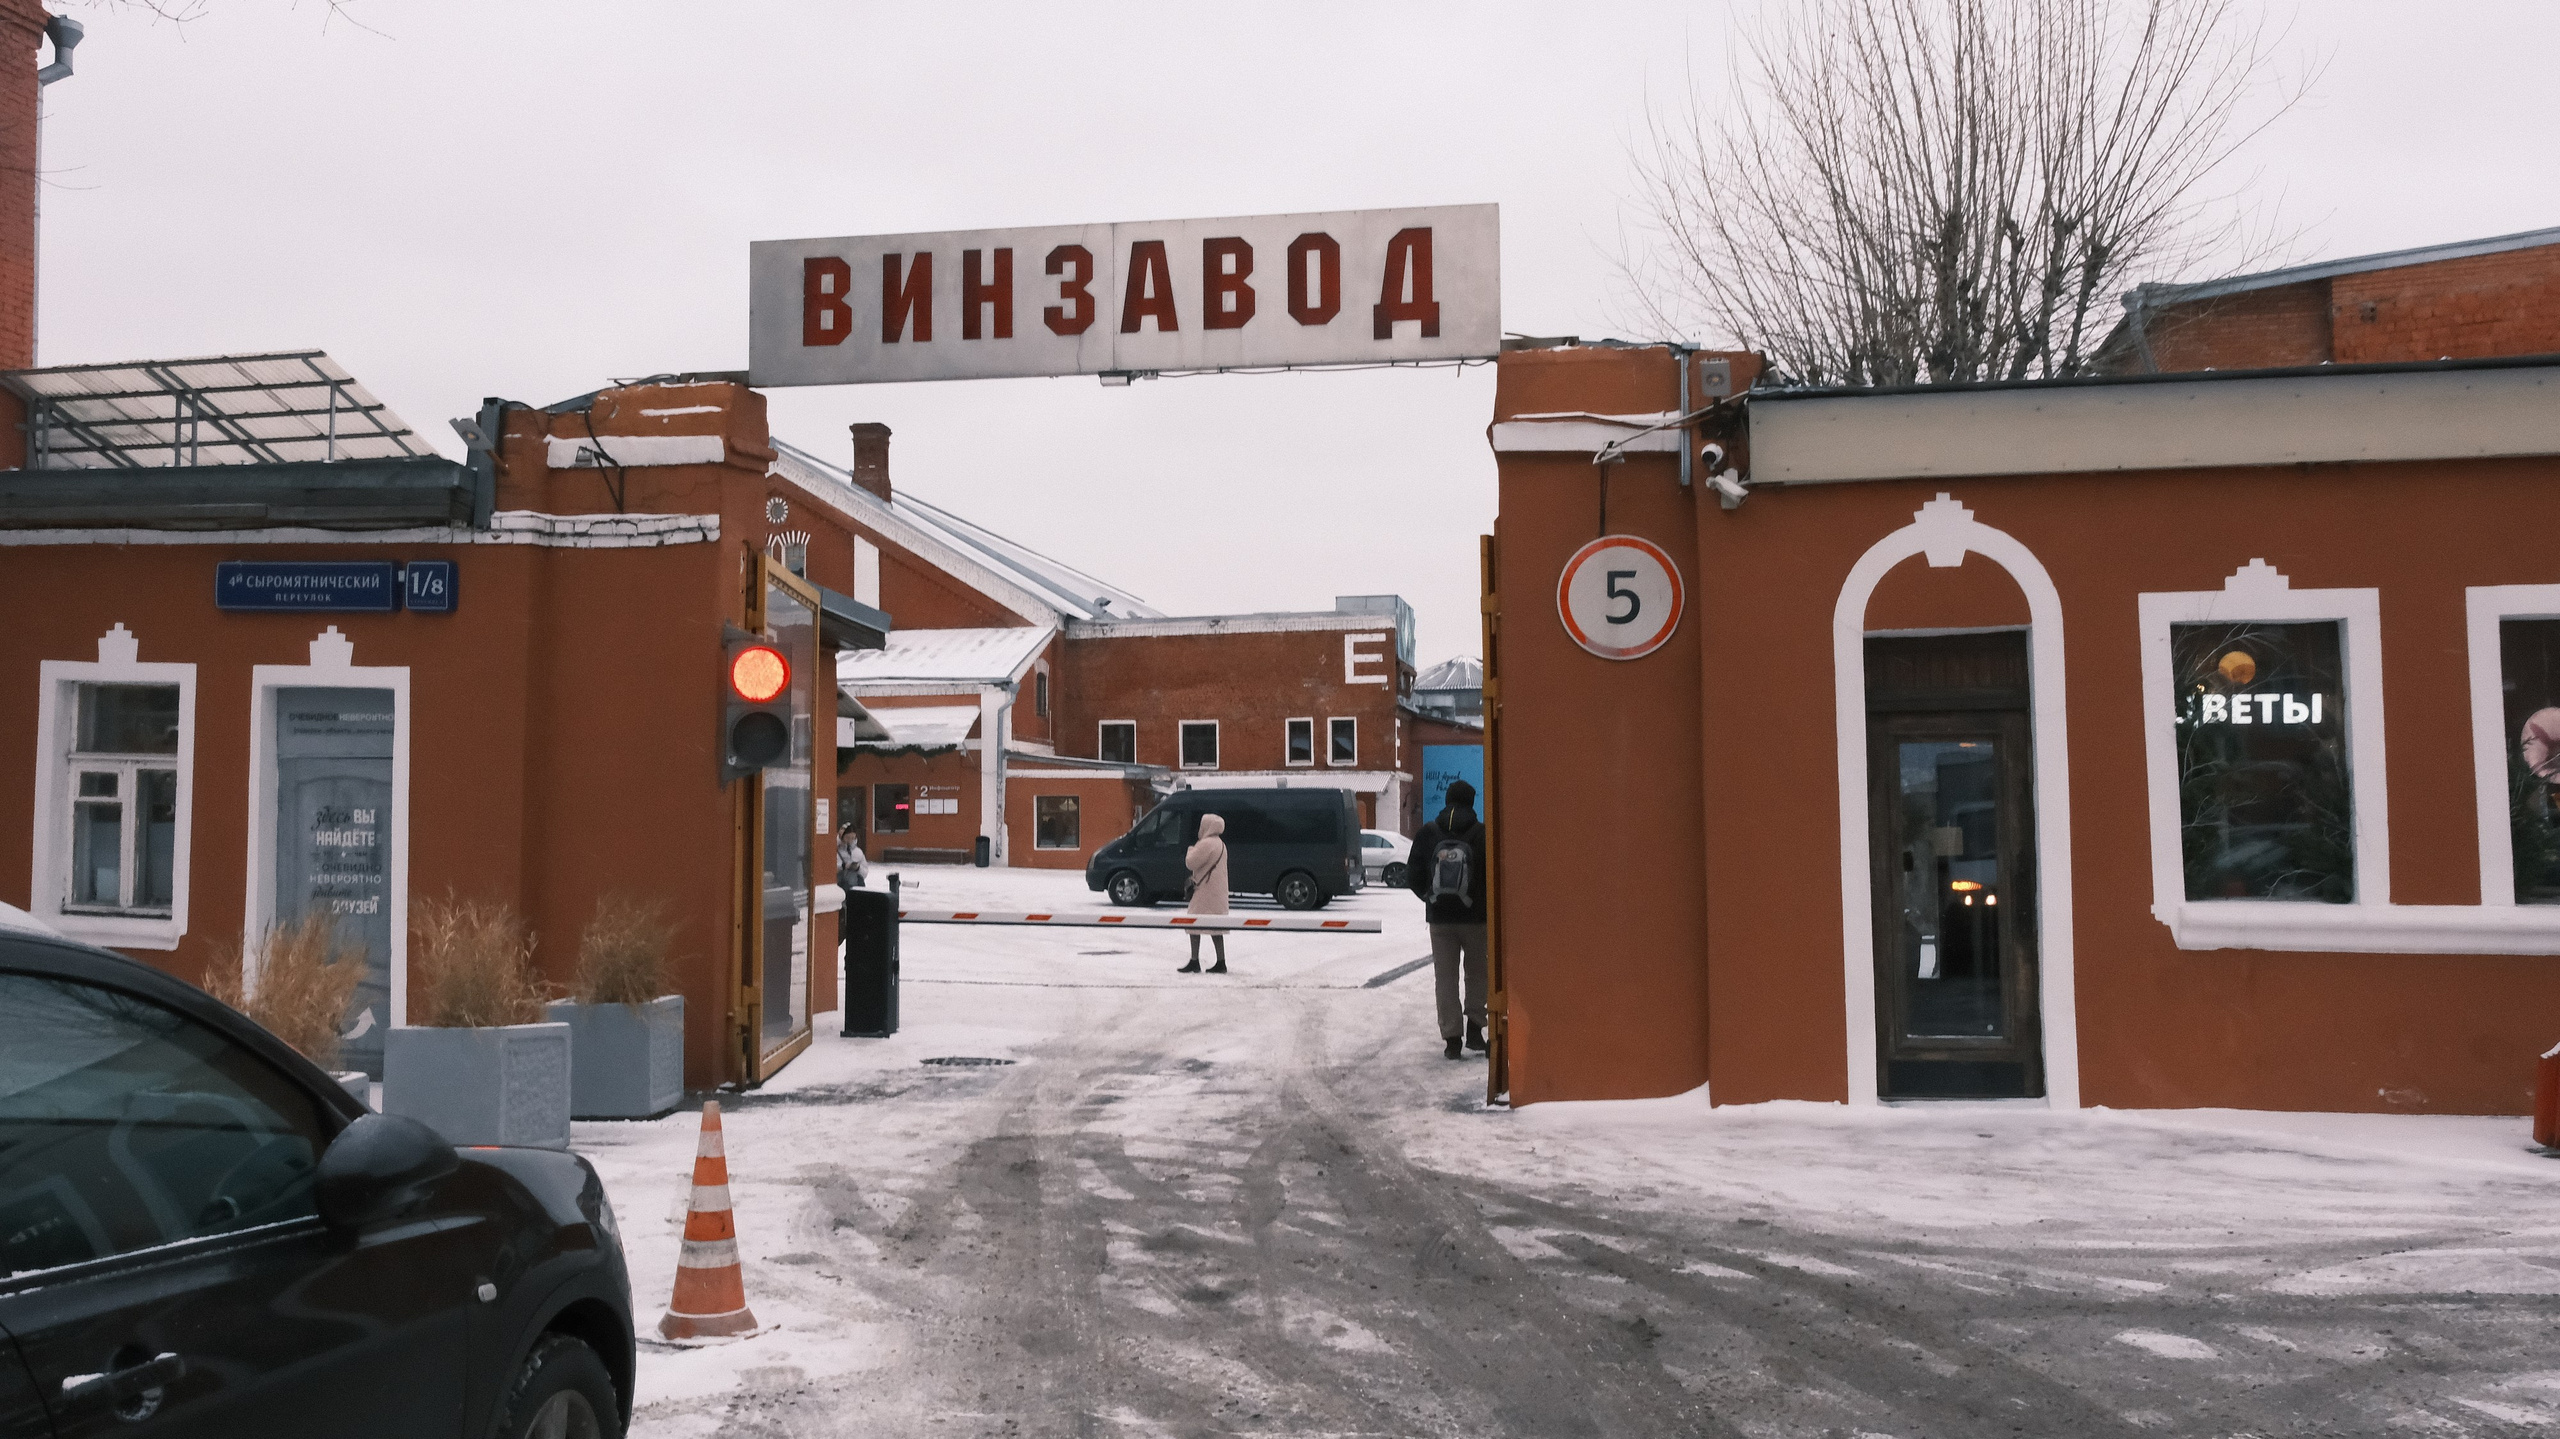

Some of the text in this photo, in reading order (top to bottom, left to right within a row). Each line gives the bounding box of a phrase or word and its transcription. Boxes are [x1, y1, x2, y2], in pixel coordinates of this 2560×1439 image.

[802, 226, 1441, 347] ВИНЗАВОД
[246, 573, 381, 589] СЫРОМЯТНИЧЕСКИЙ
[410, 570, 444, 597] 1/8
[275, 592, 332, 602] ПЕРЕУЛОК
[1605, 569, 1641, 625] 5
[2178, 692, 2323, 725] ВЕТЫ
[920, 785, 929, 798] 2
[353, 808, 376, 824] ВЫ
[316, 827, 376, 848] НАЙДЁТЕ
[322, 862, 382, 873] ОЧЕВИДНО
[308, 873, 382, 885] НЕВЕРОЯТНО
